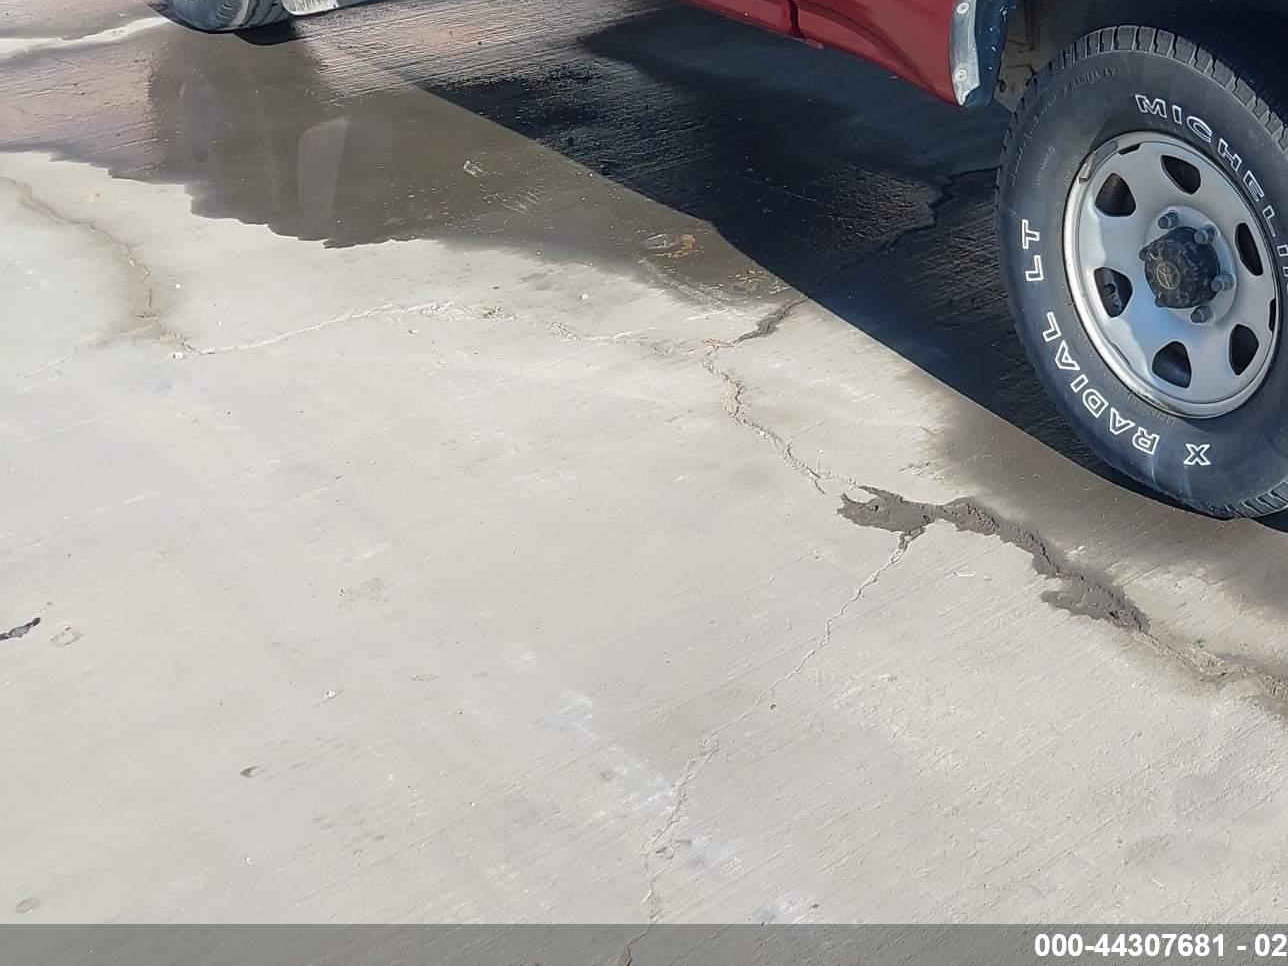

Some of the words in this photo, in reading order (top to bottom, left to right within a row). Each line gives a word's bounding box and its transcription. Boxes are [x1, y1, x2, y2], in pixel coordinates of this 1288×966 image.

[1021, 218, 1045, 282] LT
[1042, 311, 1161, 455] RADIAL
[1182, 442, 1212, 466] X
